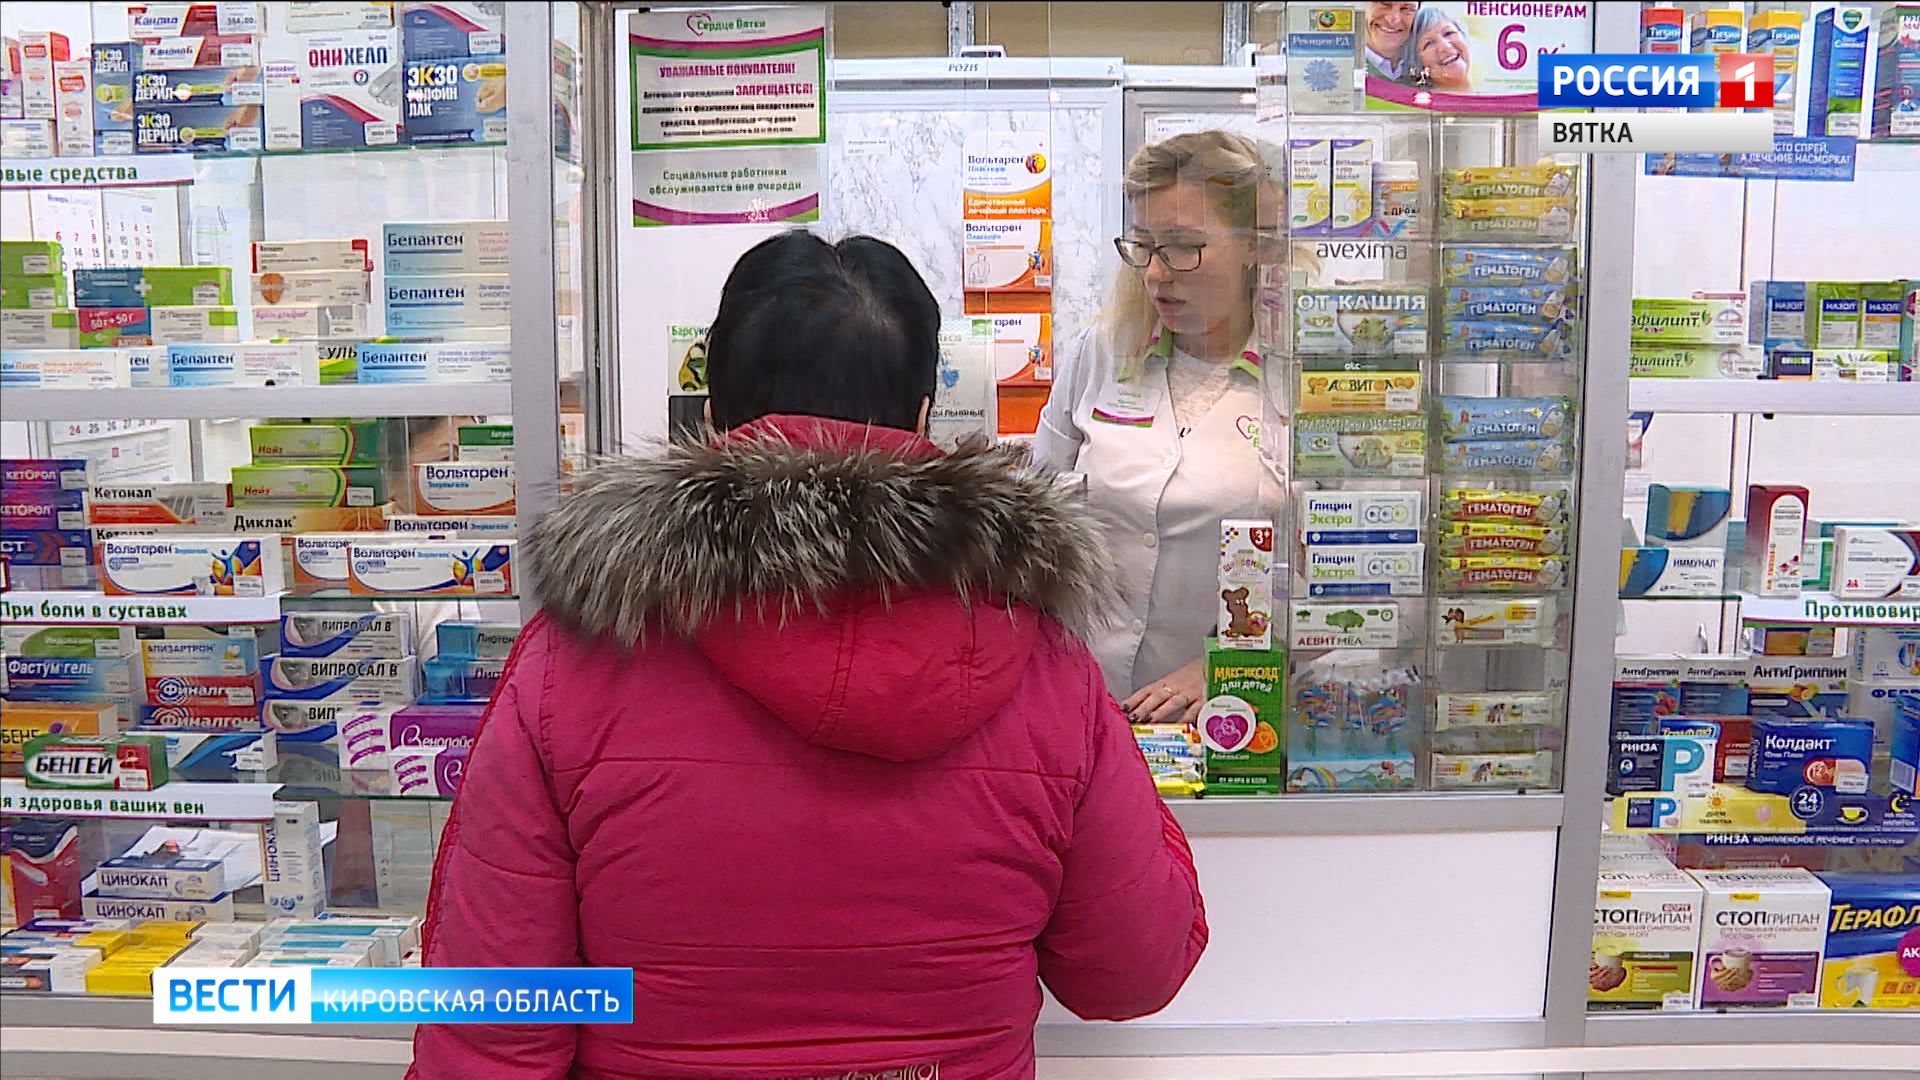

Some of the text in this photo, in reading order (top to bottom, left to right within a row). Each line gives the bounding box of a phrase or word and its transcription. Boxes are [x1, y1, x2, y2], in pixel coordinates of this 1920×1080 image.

[1467, 2, 1586, 18] ПЕНСИОНЕРАМ
[1498, 24, 1527, 70] 6
[308, 47, 388, 68] ОНИХЕЛП
[96, 61, 128, 74] ДЕРИЛ
[660, 63, 796, 78] УВАЖАЕМЫЕ ПОКУПАТЕЛИ!
[948, 63, 978, 72] POZIS
[136, 74, 167, 88] ЭКЗО
[408, 65, 457, 87] ЭКЗО
[736, 84, 813, 97] ЗАПРЕЩАЕТСЯ!
[408, 103, 432, 116] ЛАК
[138, 114, 170, 127] ЭКЗО
[138, 127, 178, 144] ДЕРИЛ
[50, 166, 138, 186] средства
[664, 168, 787, 181] Социальные работники
[649, 182, 802, 196] обслуживаются вне очереди
[1473, 185, 1540, 197] ГЕМАТОГЕН
[1471, 220, 1538, 230] ГЕМАТОГЕН
[388, 234, 463, 246] Бепантен
[1317, 242, 1408, 260] avexima
[1474, 266, 1540, 278] ГЕМАТОГЕН
[389, 287, 464, 300] Бепантен
[1298, 294, 1426, 311] ОТ КАШЛЯ
[1470, 303, 1536, 316] ГЕМАТОГЕН
[1470, 338, 1536, 350] ГЕМАТОГЕН
[172, 352, 234, 366] Бепантен
[362, 350, 428, 364] Бепантен
[88, 422, 100, 434] 25
[1471, 422, 1536, 436] ГЕМАТОГЕН
[1467, 455, 1533, 468] ГЕМАТОГЕН
[6, 470, 56, 480] КЕТОРОЛ
[426, 466, 508, 480] Вольтарен
[94, 488, 152, 498] Кетонал
[1309, 500, 1352, 512] Глицин
[1468, 503, 1532, 516] ГЕМАТОГЕН
[234, 516, 292, 532] Диклак
[394, 520, 468, 532] Вольтарен
[1309, 514, 1352, 526] Экстра
[107, 543, 172, 556] Вольтарен
[1470, 538, 1536, 550] ГЕМАТОГЕН
[354, 548, 416, 560] Вольтарен
[1312, 552, 1355, 565] Глицин
[1673, 558, 1717, 568] ИММУНАЛ
[1312, 566, 1356, 579] Экстра
[1468, 570, 1533, 582] ГЕМАТОГЕН
[0, 600, 187, 620] При боли в суставах
[322, 620, 382, 632] ВИПРОСАЛ
[8, 660, 94, 677] Фастум гель
[311, 663, 398, 677] ВИПРОСАЛ В
[1752, 665, 1847, 680] АнтиГриппин
[1621, 744, 1657, 752] РИНЗА
[1765, 734, 1832, 751] Колдакт
[36, 755, 112, 774] БЕНГЕЙ
[1, 797, 204, 814] я здоровья ваших вен
[1798, 794, 1818, 804] 24
[1706, 834, 1750, 844] РИНЗА
[100, 870, 168, 887] ЦИНОКАП
[97, 905, 165, 919] ЦИНОКАП
[1717, 910, 1821, 926] СТОПГРИПАН
